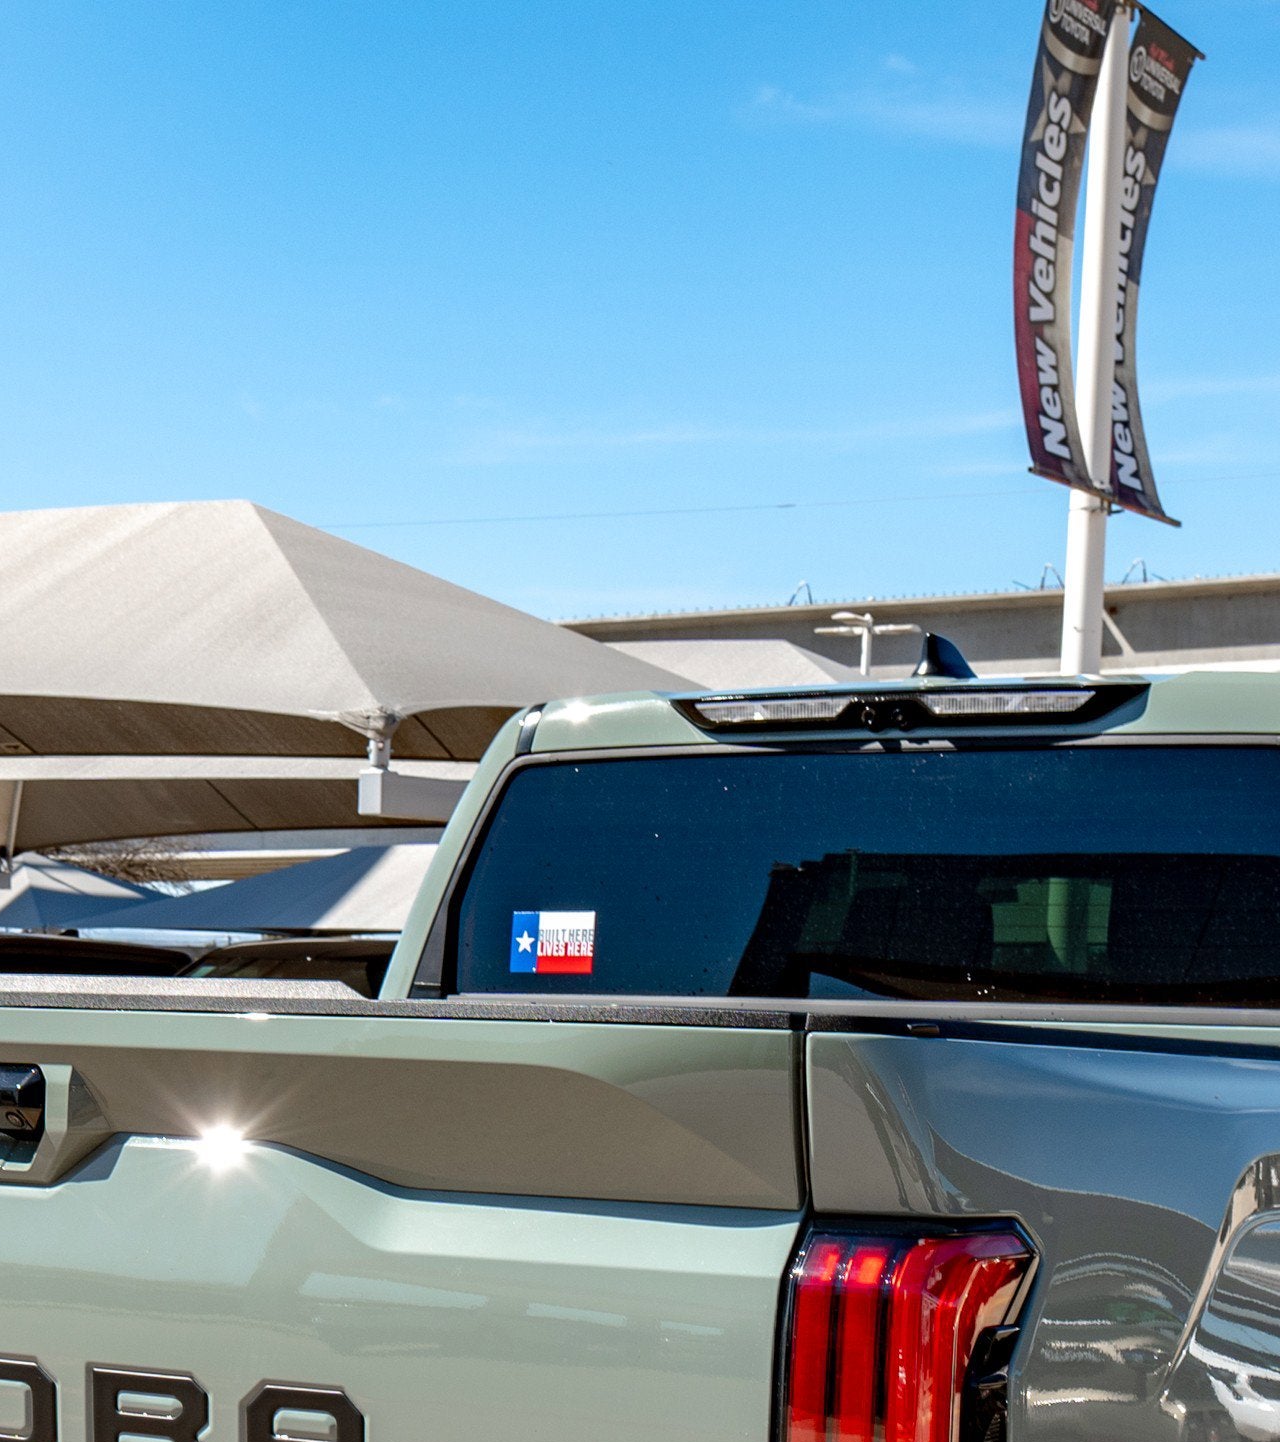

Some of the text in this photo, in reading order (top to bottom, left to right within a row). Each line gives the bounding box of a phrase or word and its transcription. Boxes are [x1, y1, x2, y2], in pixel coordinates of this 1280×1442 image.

[1061, 13, 1090, 45] TOYOTA
[1029, 91, 1072, 460] New Vehicles
[539, 929, 594, 942] BUILT HERE
[537, 942, 594, 957] LIVES HERE
